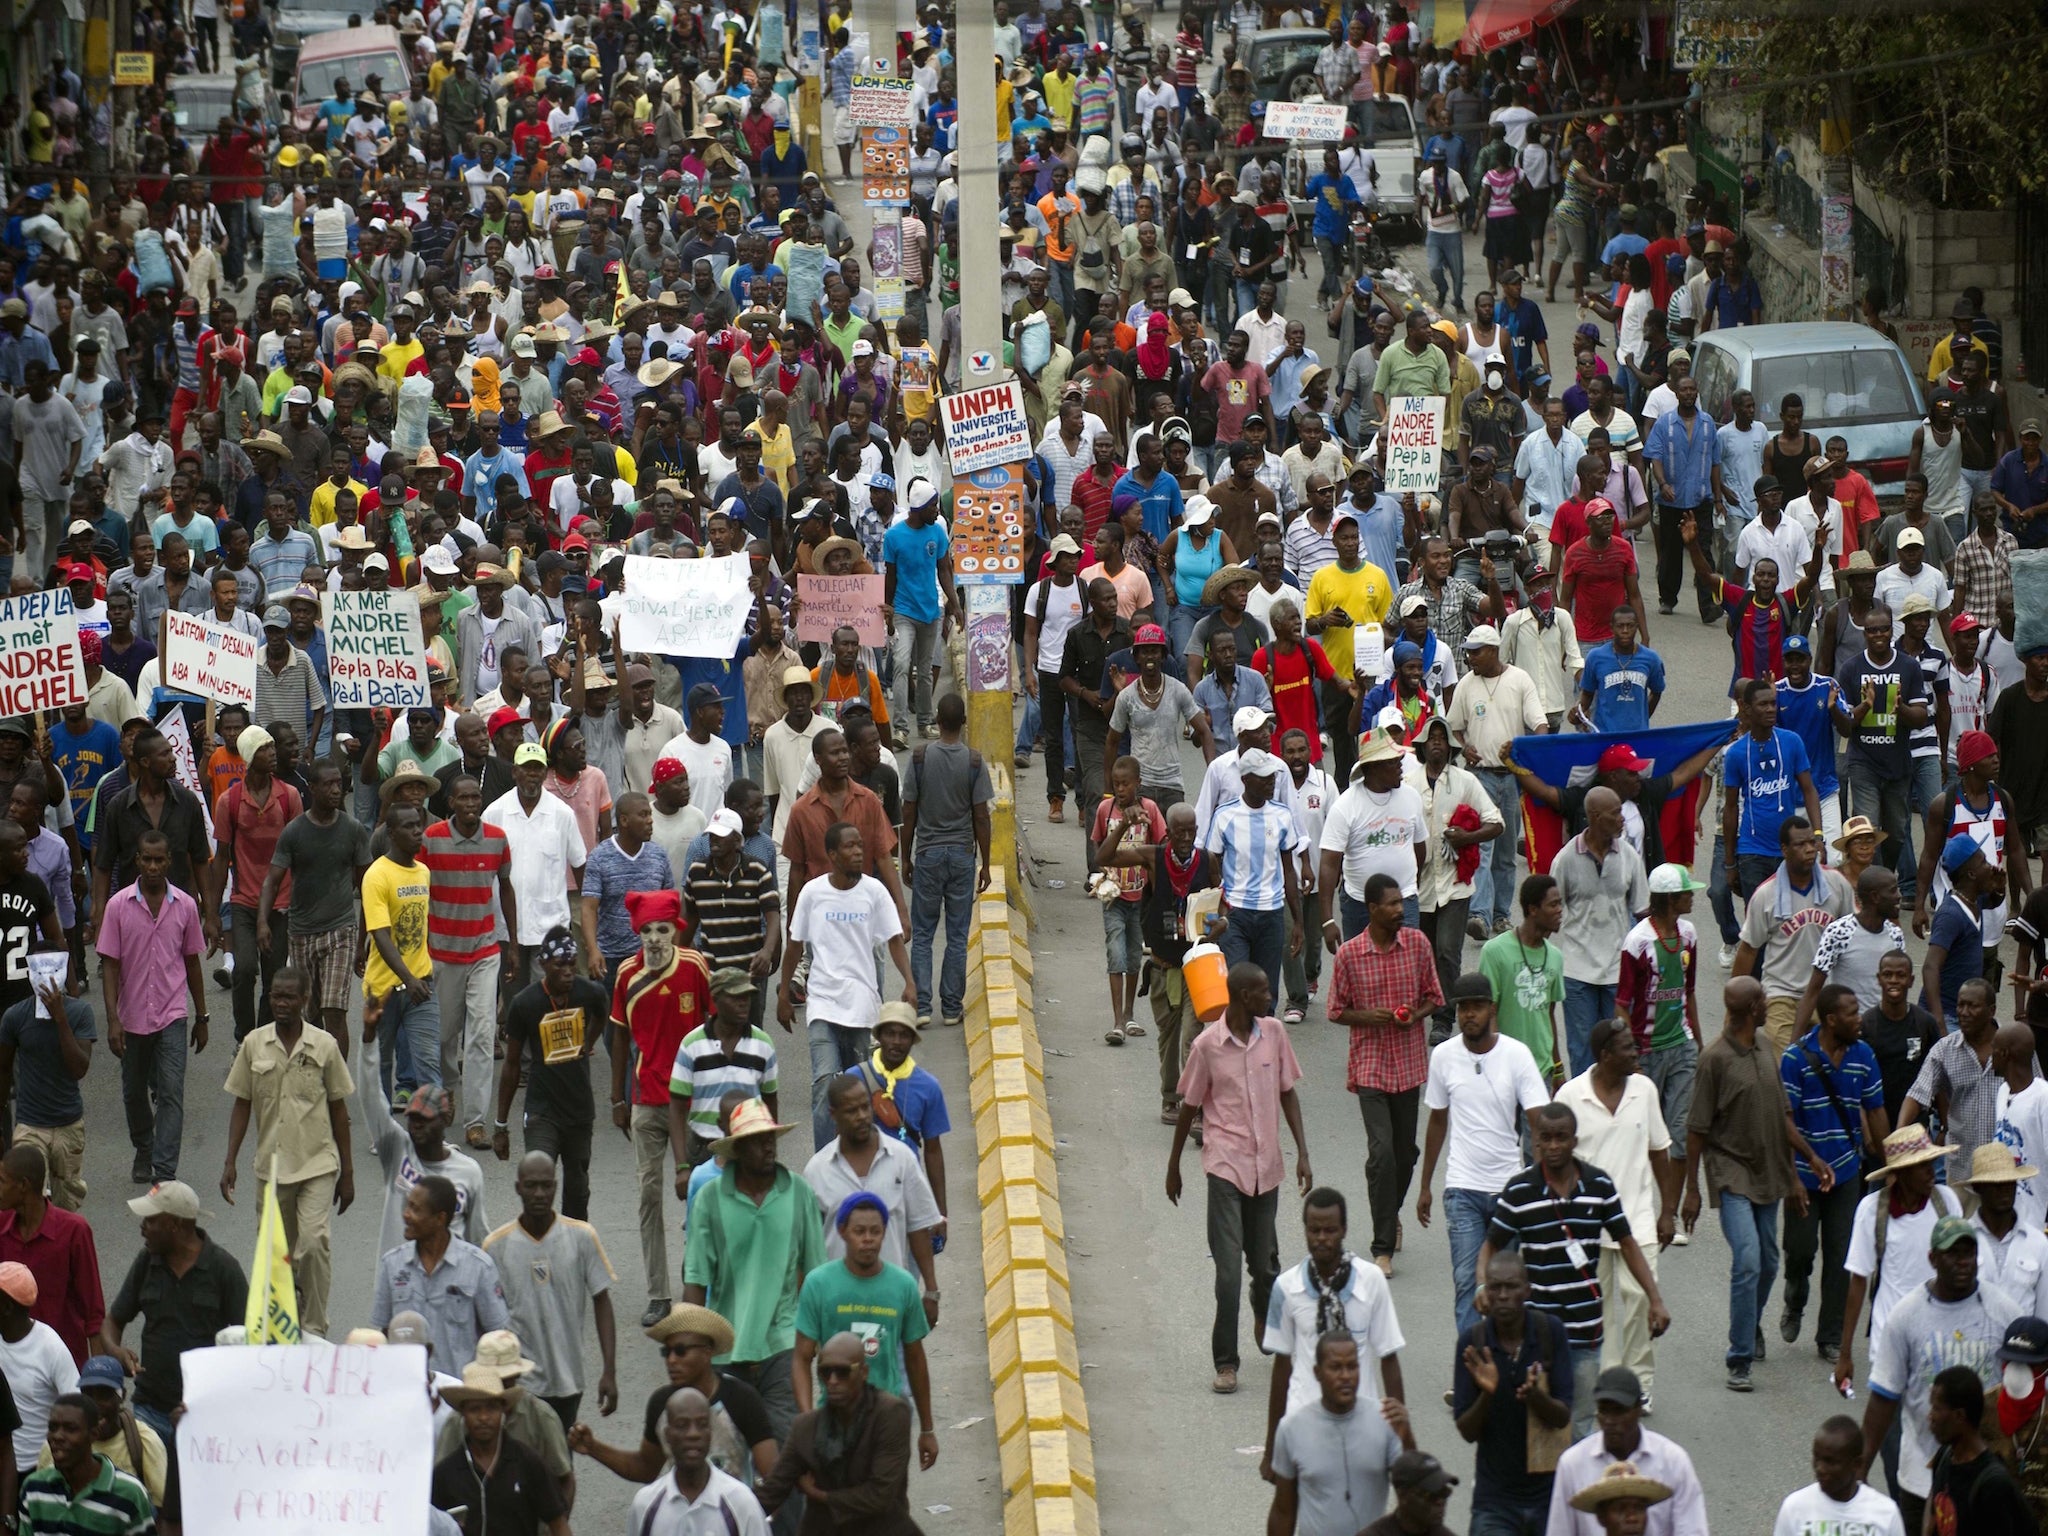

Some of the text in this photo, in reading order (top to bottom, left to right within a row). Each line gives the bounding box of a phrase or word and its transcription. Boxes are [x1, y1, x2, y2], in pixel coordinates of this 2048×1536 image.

[853, 77, 914, 90] URH-ISAG
[948, 385, 1013, 421] UNPH
[952, 409, 1017, 434] UNIVERSITE
[1393, 413, 1435, 430] ANDRE
[948, 429, 995, 448] Patronale
[973, 439, 1008, 453] Delmas
[1010, 433, 1022, 444] 53
[1390, 431, 1437, 447] MICHEL
[1392, 447, 1431, 469] Pèp la
[978, 473, 1005, 484] DEAL
[1398, 468, 1421, 488] Tann
[55, 588, 74, 616] LA
[334, 591, 392, 612] AK Mèt
[803, 601, 853, 613] MARTELLY
[330, 613, 409, 633] ANDRE
[12, 619, 53, 648] mèt
[170, 616, 207, 644] PLATFOM
[222, 634, 255, 659] DESALIN
[332, 635, 414, 656] MICHEL
[207, 651, 217, 667] DI
[330, 656, 356, 680] Pèp
[357, 658, 371, 678] la
[172, 661, 252, 701] ABA MINUSTHA
[1861, 673, 1900, 685] DRIVE
[333, 679, 424, 707] Pèdi Batay
[1877, 714, 1897, 726] UR
[1860, 735, 1896, 745] SCHOOL
[1750, 775, 1790, 798] Gucci
